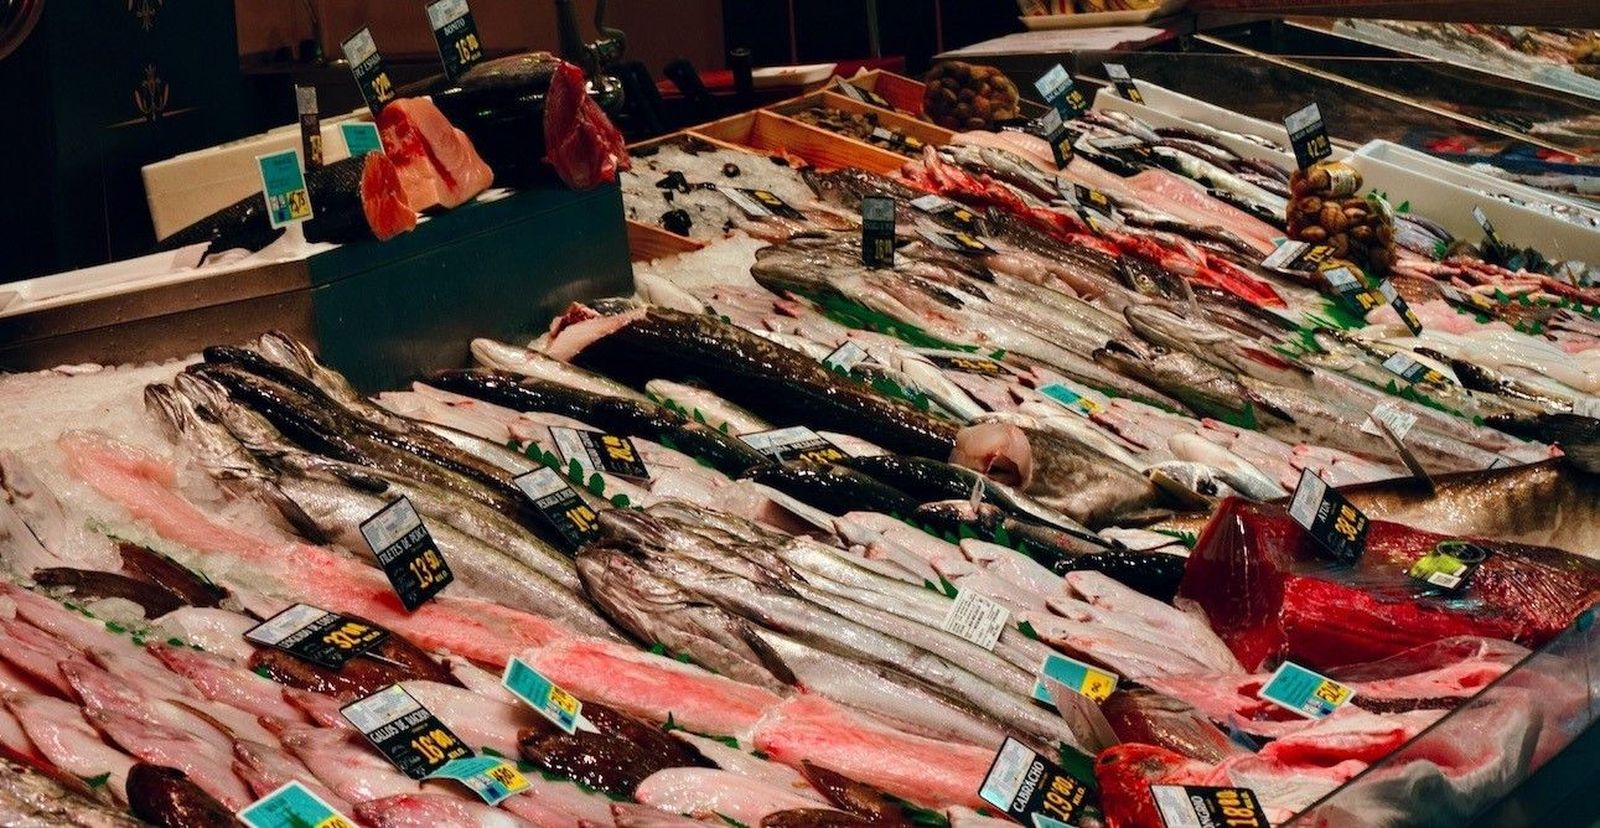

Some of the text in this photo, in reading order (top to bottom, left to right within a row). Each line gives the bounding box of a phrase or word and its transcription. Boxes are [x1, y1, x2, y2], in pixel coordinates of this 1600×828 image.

[379, 543, 404, 566] FILETES
[400, 538, 412, 550] DE
[369, 725, 399, 743] GALLOS
[395, 720, 409, 731] DE
[1012, 760, 1045, 813] CABRACHO
